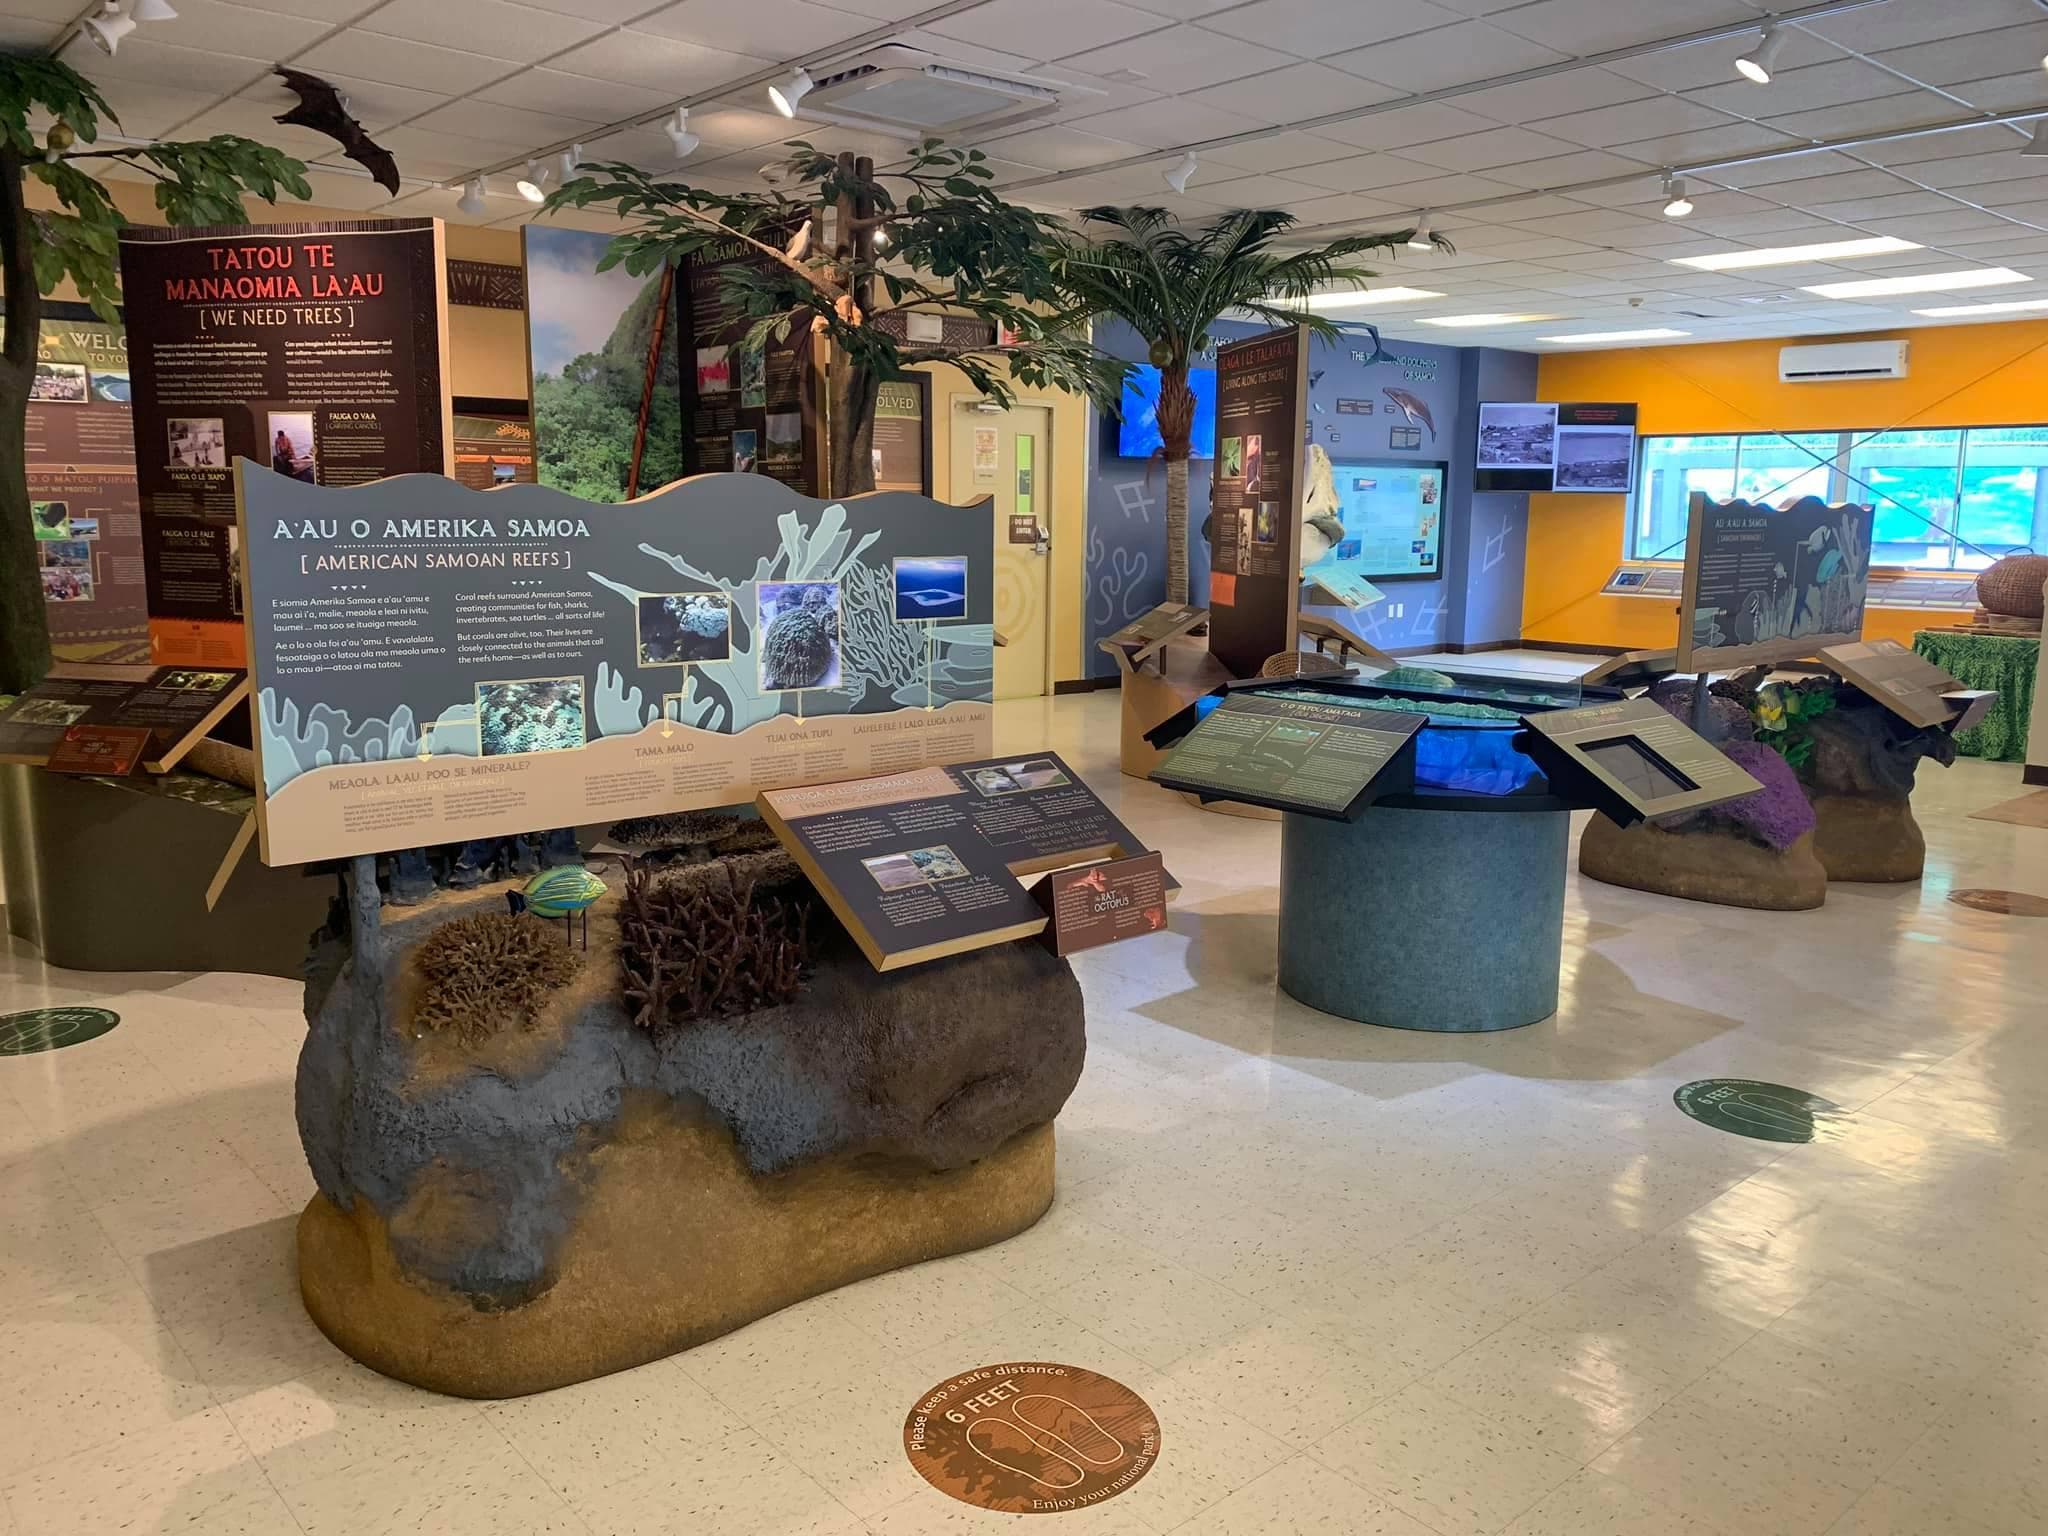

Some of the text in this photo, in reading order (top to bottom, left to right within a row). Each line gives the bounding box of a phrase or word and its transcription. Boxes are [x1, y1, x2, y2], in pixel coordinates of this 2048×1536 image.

[208, 245, 334, 270] TATOU TE
[165, 275, 301, 300] MANAOMIA
[212, 308, 342, 326] WE NEED TREES
[89, 353, 104, 361] TO
[1352, 351, 1366, 361] THE
[273, 519, 590, 539] A'AU O AMERIKA SAMOA
[316, 551, 558, 571] AMERICAN SAMOAN REEFS
[310, 598, 345, 606] Amerika
[347, 597, 376, 605] Samoa
[456, 593, 476, 601] Coral
[477, 592, 495, 600] reefs
[384, 607, 398, 615] leai
[456, 604, 486, 613] creating
[488, 603, 535, 611] communities
[537, 602, 547, 610] for
[456, 615, 508, 624] invertebrates,
[357, 621, 385, 630] ituaiga
[457, 633, 471, 641] But
[472, 632, 494, 640] corals
[509, 631, 528, 639] alive,
[546, 629, 563, 637] Their
[329, 639, 339, 647] foi
[458, 644, 483, 653] closely
[485, 642, 523, 651] connected
[338, 651, 359, 659] latou
[459, 656, 471, 664] the
[473, 655, 491, 663] reefs
[378, 660, 403, 668] tatou.
[635, 744, 694, 757] TAMA MALO
[427, 769, 450, 780] POO
[455, 767, 467, 777] SE
[471, 761, 530, 775] MINERALE?
[1094, 897, 1129, 912] OCTOPUS
[1705, 1086, 1738, 1101] FEET
[945, 1379, 1022, 1424] 6 FEET
[912, 1365, 1068, 1451] Please keep a safe distance.
[1033, 1497, 1077, 1510] Enjoy
[1079, 1488, 1111, 1507] your
[1111, 1455, 1149, 1491] national
